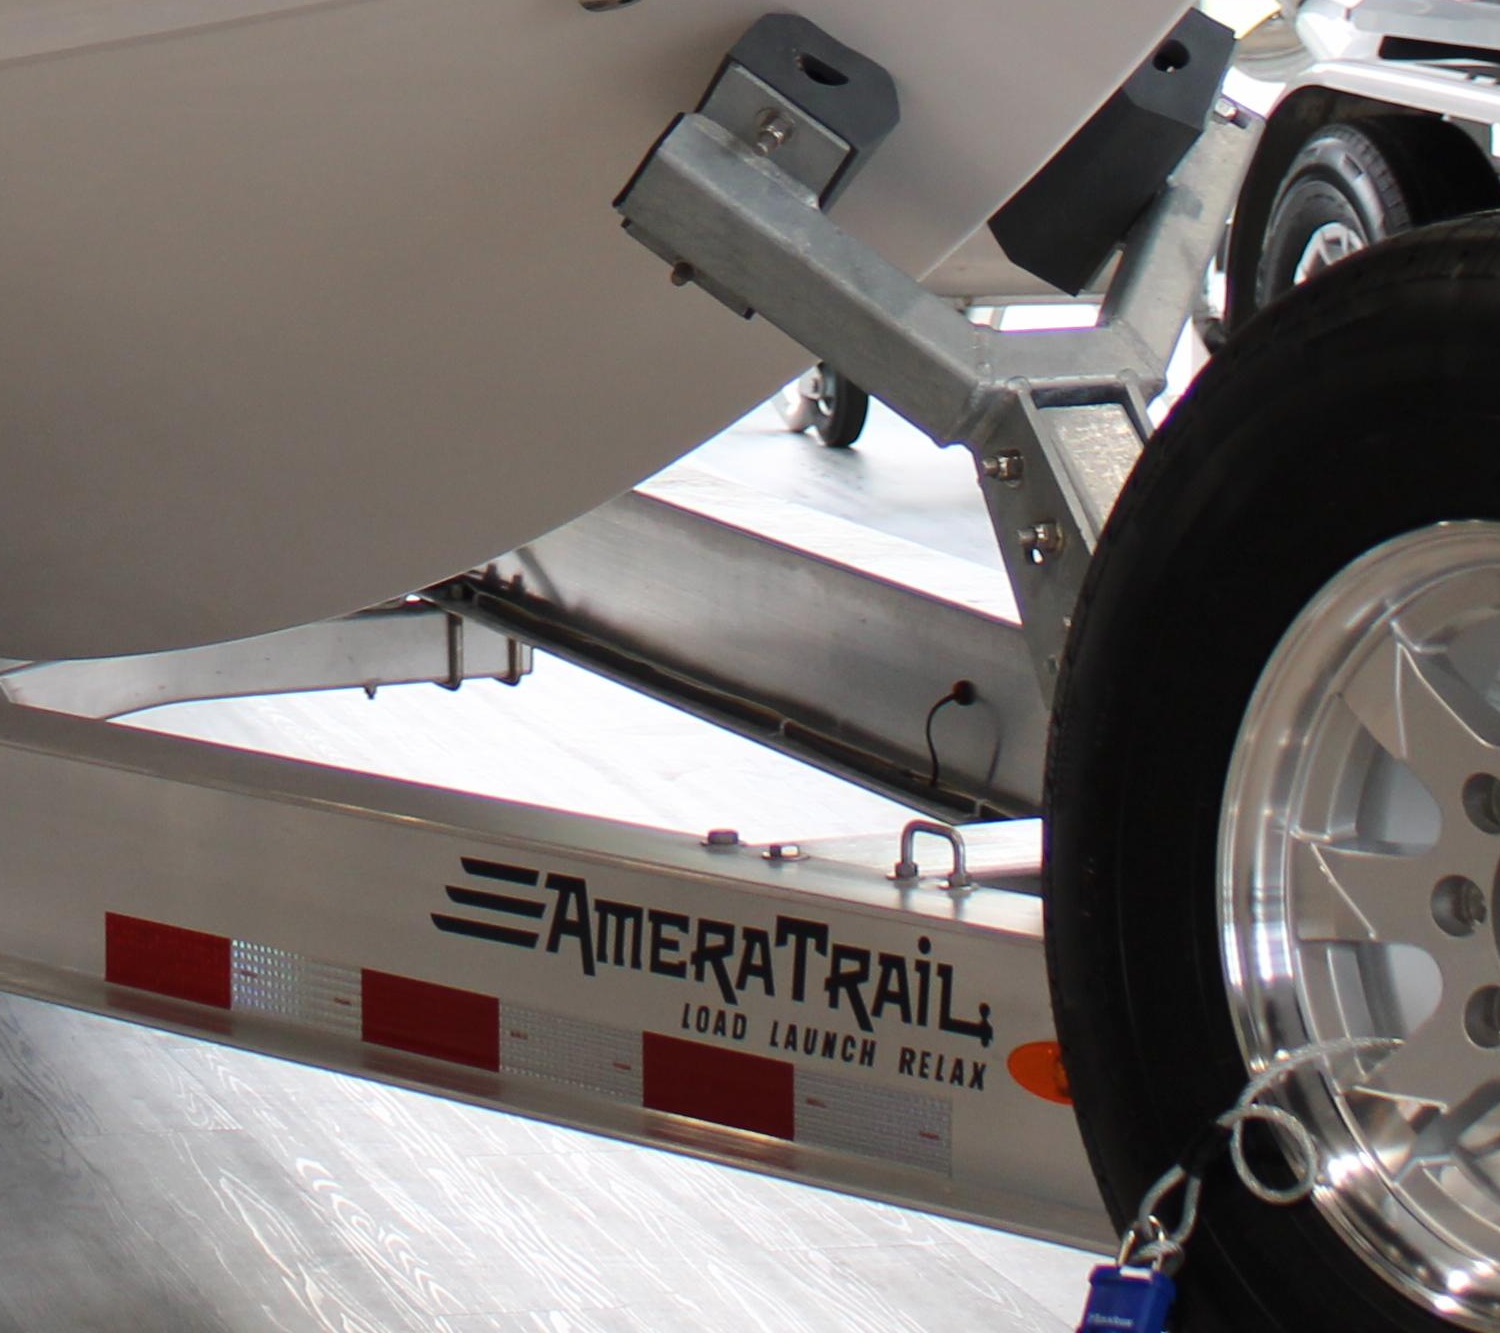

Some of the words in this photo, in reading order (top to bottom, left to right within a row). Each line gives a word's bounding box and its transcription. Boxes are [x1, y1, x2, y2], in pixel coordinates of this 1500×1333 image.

[681, 1002, 748, 1041] LOAD
[769, 1020, 877, 1068] LAUNCH
[898, 1046, 988, 1091] RELAX
